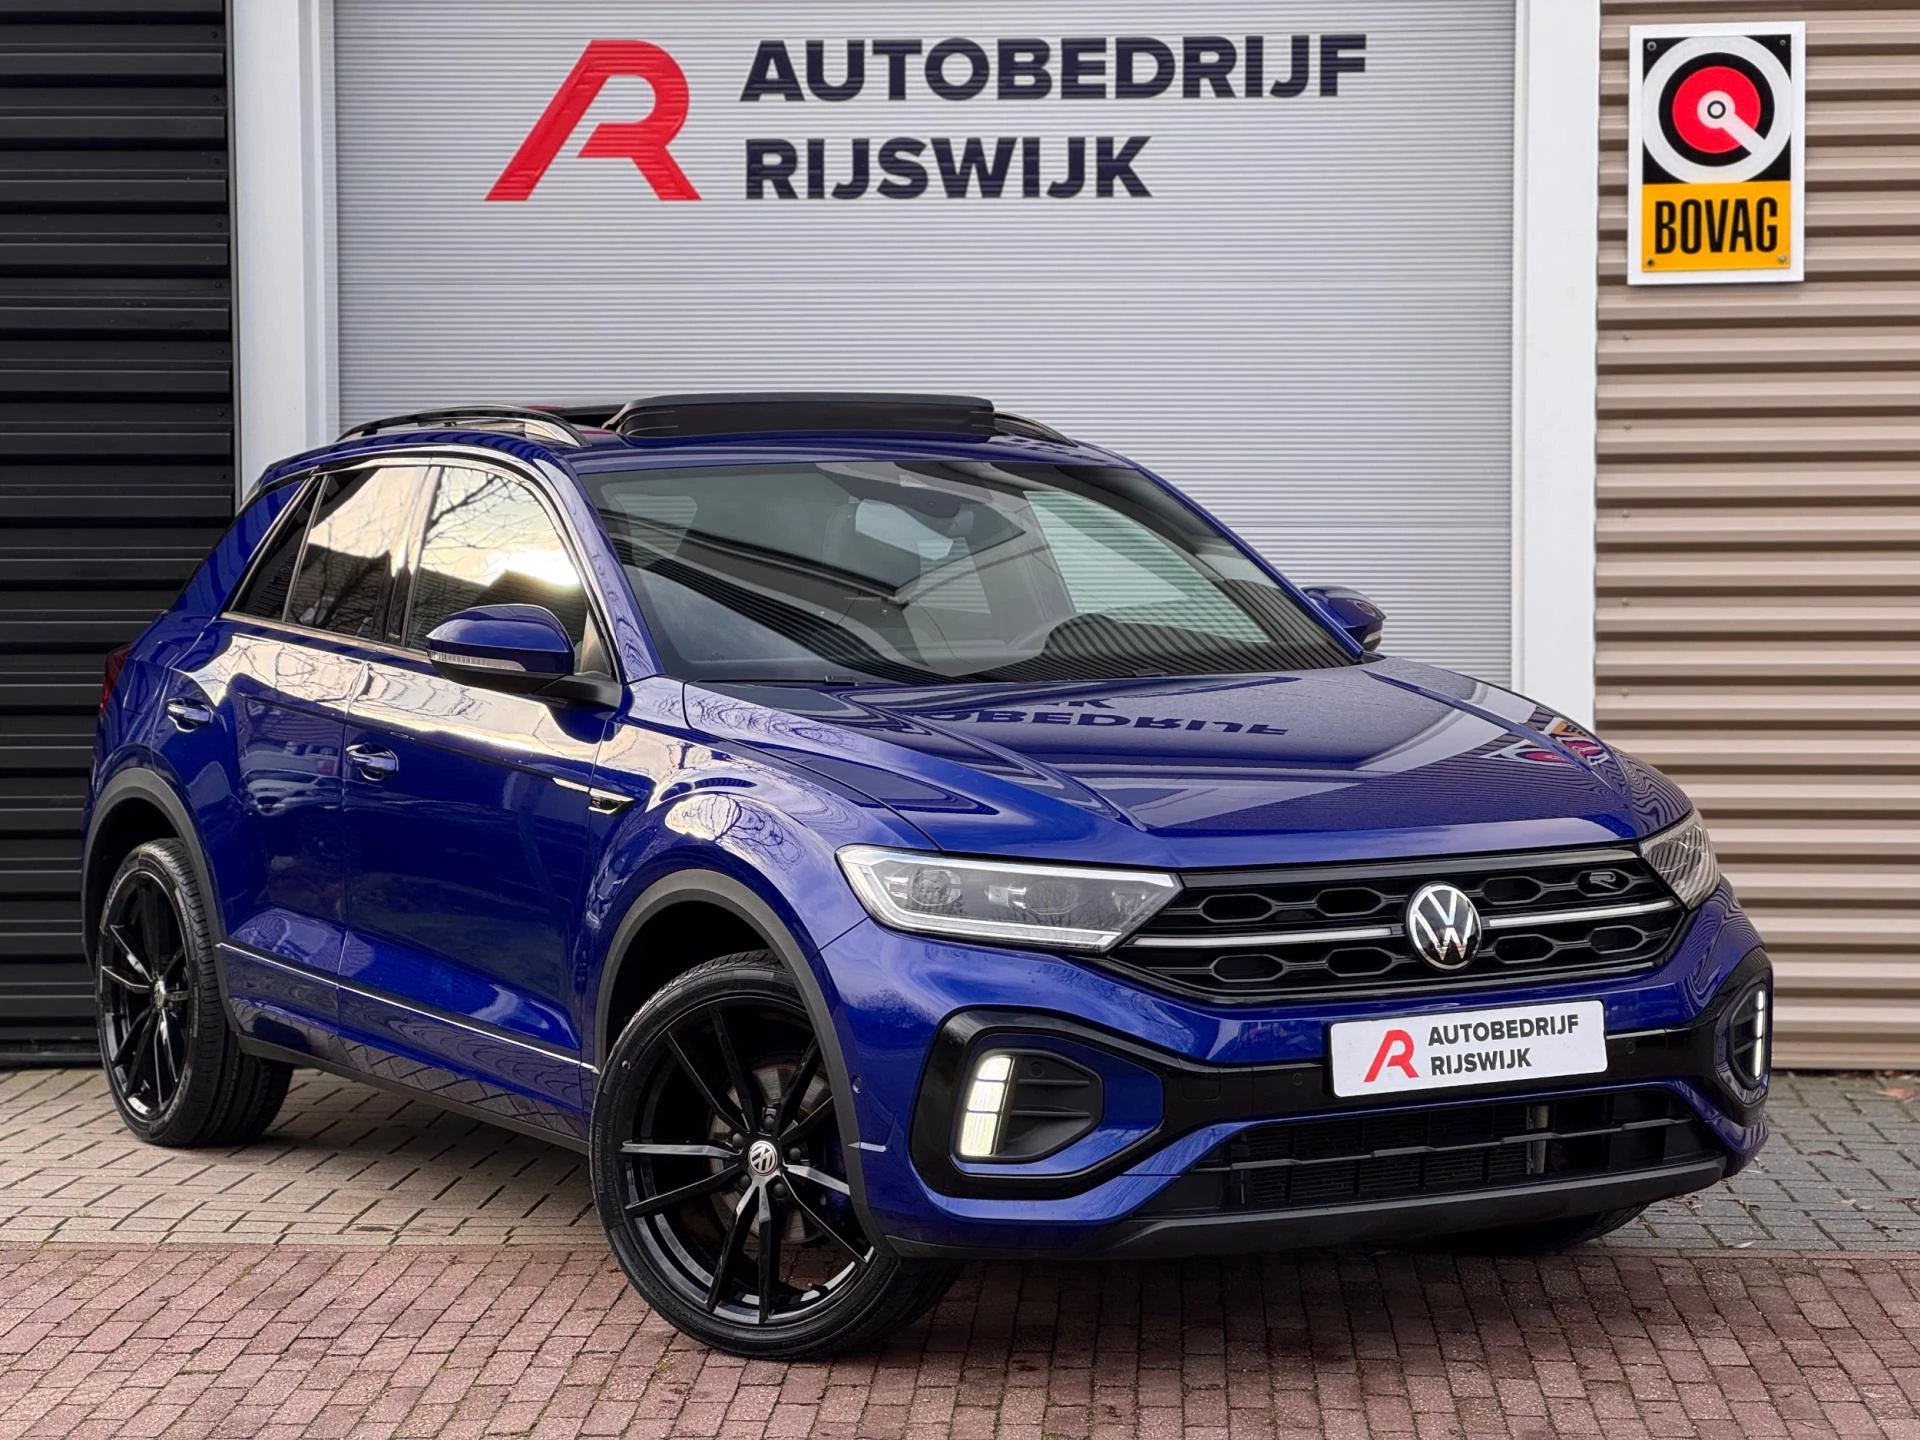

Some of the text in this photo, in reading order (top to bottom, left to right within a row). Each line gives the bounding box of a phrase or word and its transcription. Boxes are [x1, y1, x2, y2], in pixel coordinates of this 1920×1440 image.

[741, 34, 1367, 102] AUTOBEDRIJF
[745, 136, 1153, 199] RIJSWIJK
[1655, 196, 1777, 254] BOVAG
[1428, 1014, 1579, 1046] AUTOBEDRIJF
[1431, 1048, 1532, 1076] RIJSWIJK
